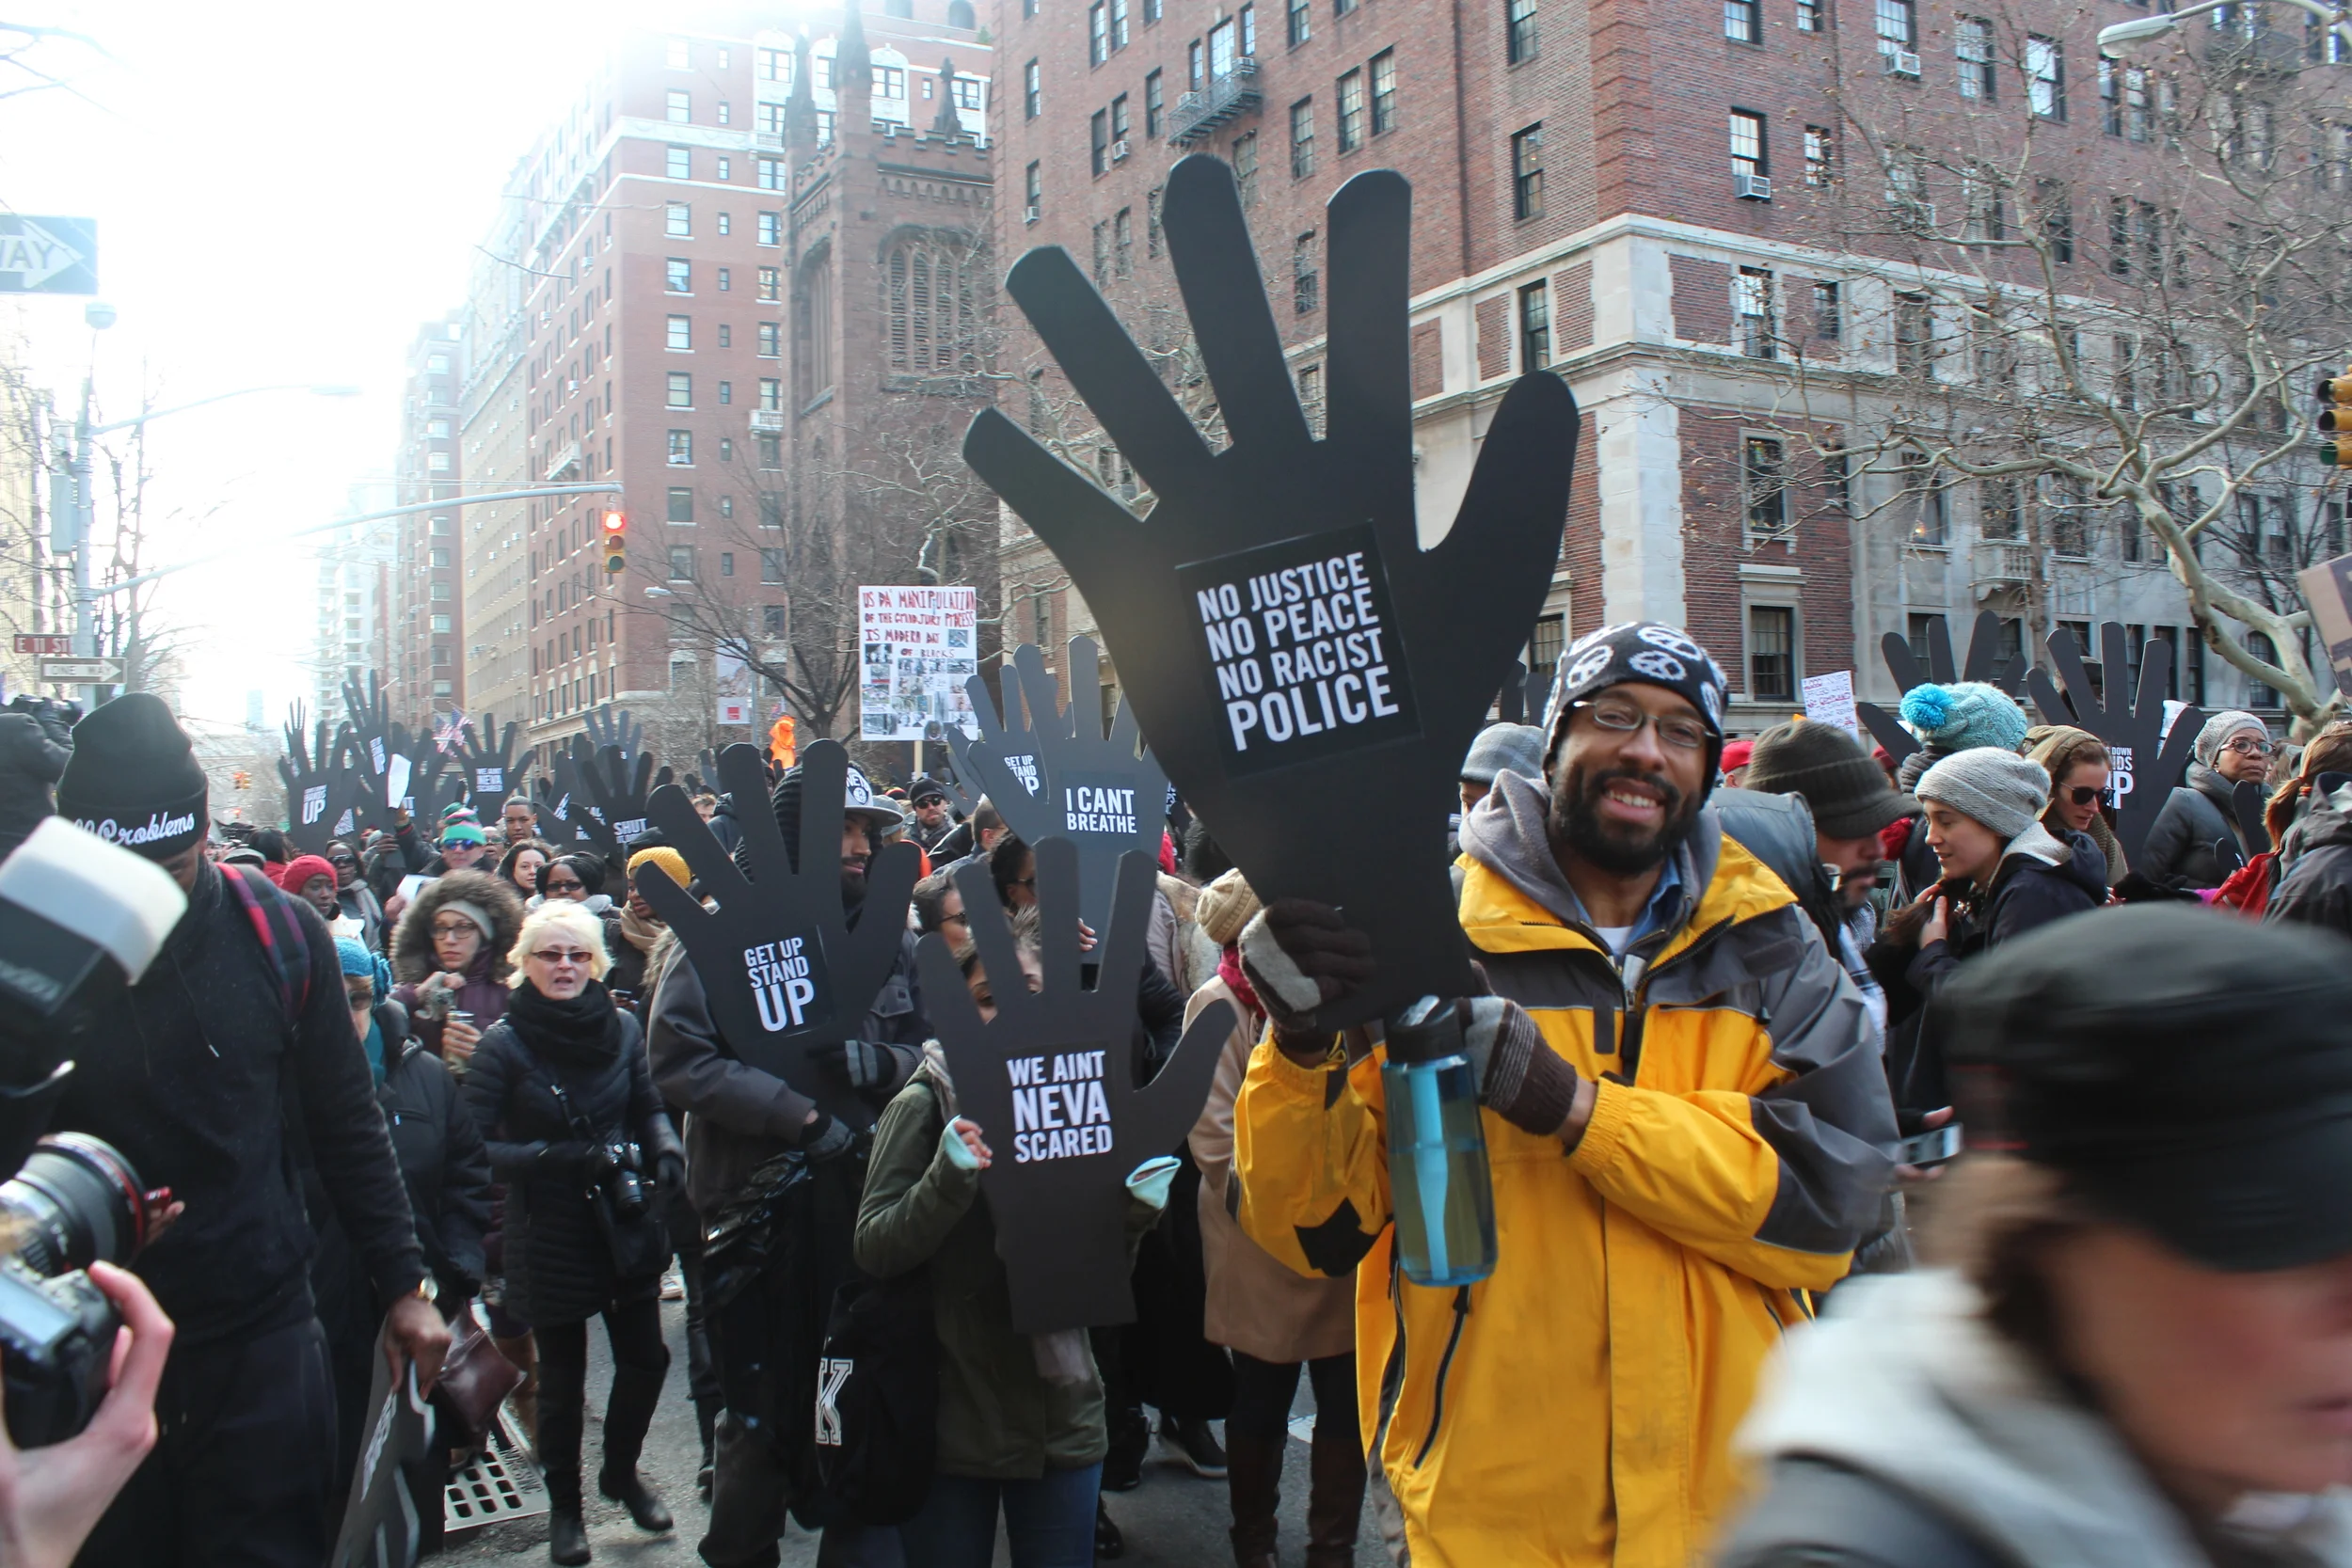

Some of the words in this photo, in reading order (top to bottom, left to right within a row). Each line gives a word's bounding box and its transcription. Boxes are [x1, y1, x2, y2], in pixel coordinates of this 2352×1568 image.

[0, 239, 55, 270] AY
[1197, 583, 1241, 624] NO
[1248, 551, 1370, 611] JUSTICE
[1205, 616, 1256, 662] NO
[1263, 586, 1379, 648] PEACE
[17, 638, 26, 652] E
[1216, 658, 1263, 701] NO
[1270, 627, 1384, 688] RACIST
[1227, 665, 1399, 752] POLICE
[1022, 754, 1034, 766] UP
[2111, 747, 2132, 756] DOWN
[1009, 765, 1037, 778] TAND
[302, 799, 326, 825] UP
[1066, 788, 1073, 812] I
[1077, 786, 1135, 815] CANT
[97, 811, 195, 846] Problems
[613, 817, 647, 836] SHUT
[1067, 813, 1137, 834] BREATHE
[744, 942, 775, 967] GET
[778, 937, 803, 958] UP
[747, 956, 809, 989] STAND
[754, 977, 815, 1032] UP
[1006, 1056, 1047, 1087] WE
[1052, 1050, 1106, 1083] AINT
[1011, 1081, 1111, 1132] NEVA
[1013, 1124, 1114, 1164] SCARED
